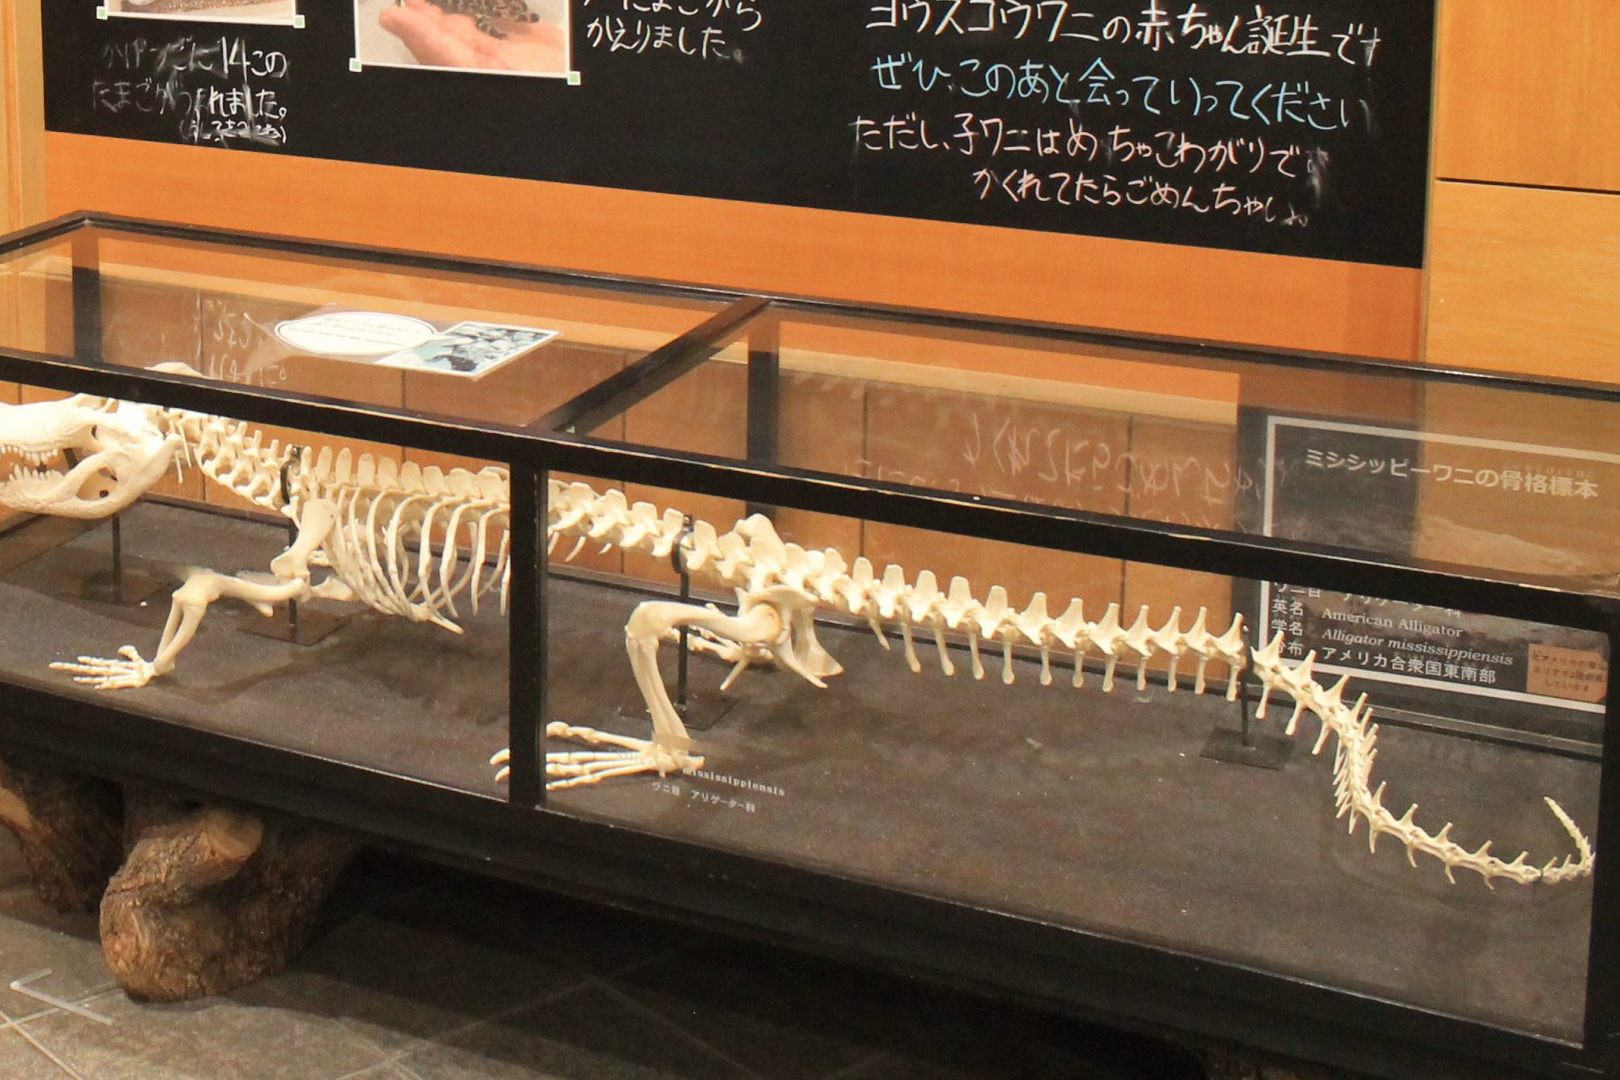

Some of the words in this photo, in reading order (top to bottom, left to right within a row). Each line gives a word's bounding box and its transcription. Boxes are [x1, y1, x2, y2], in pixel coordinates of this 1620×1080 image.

[1271, 597, 1305, 618] 英名
[1321, 607, 1393, 629] American
[1398, 617, 1464, 639] Alligator
[1321, 627, 1385, 647] Alligator
[1387, 637, 1514, 667] mississippiensis
[1321, 645, 1497, 685] アメリカ合衆国東南部
